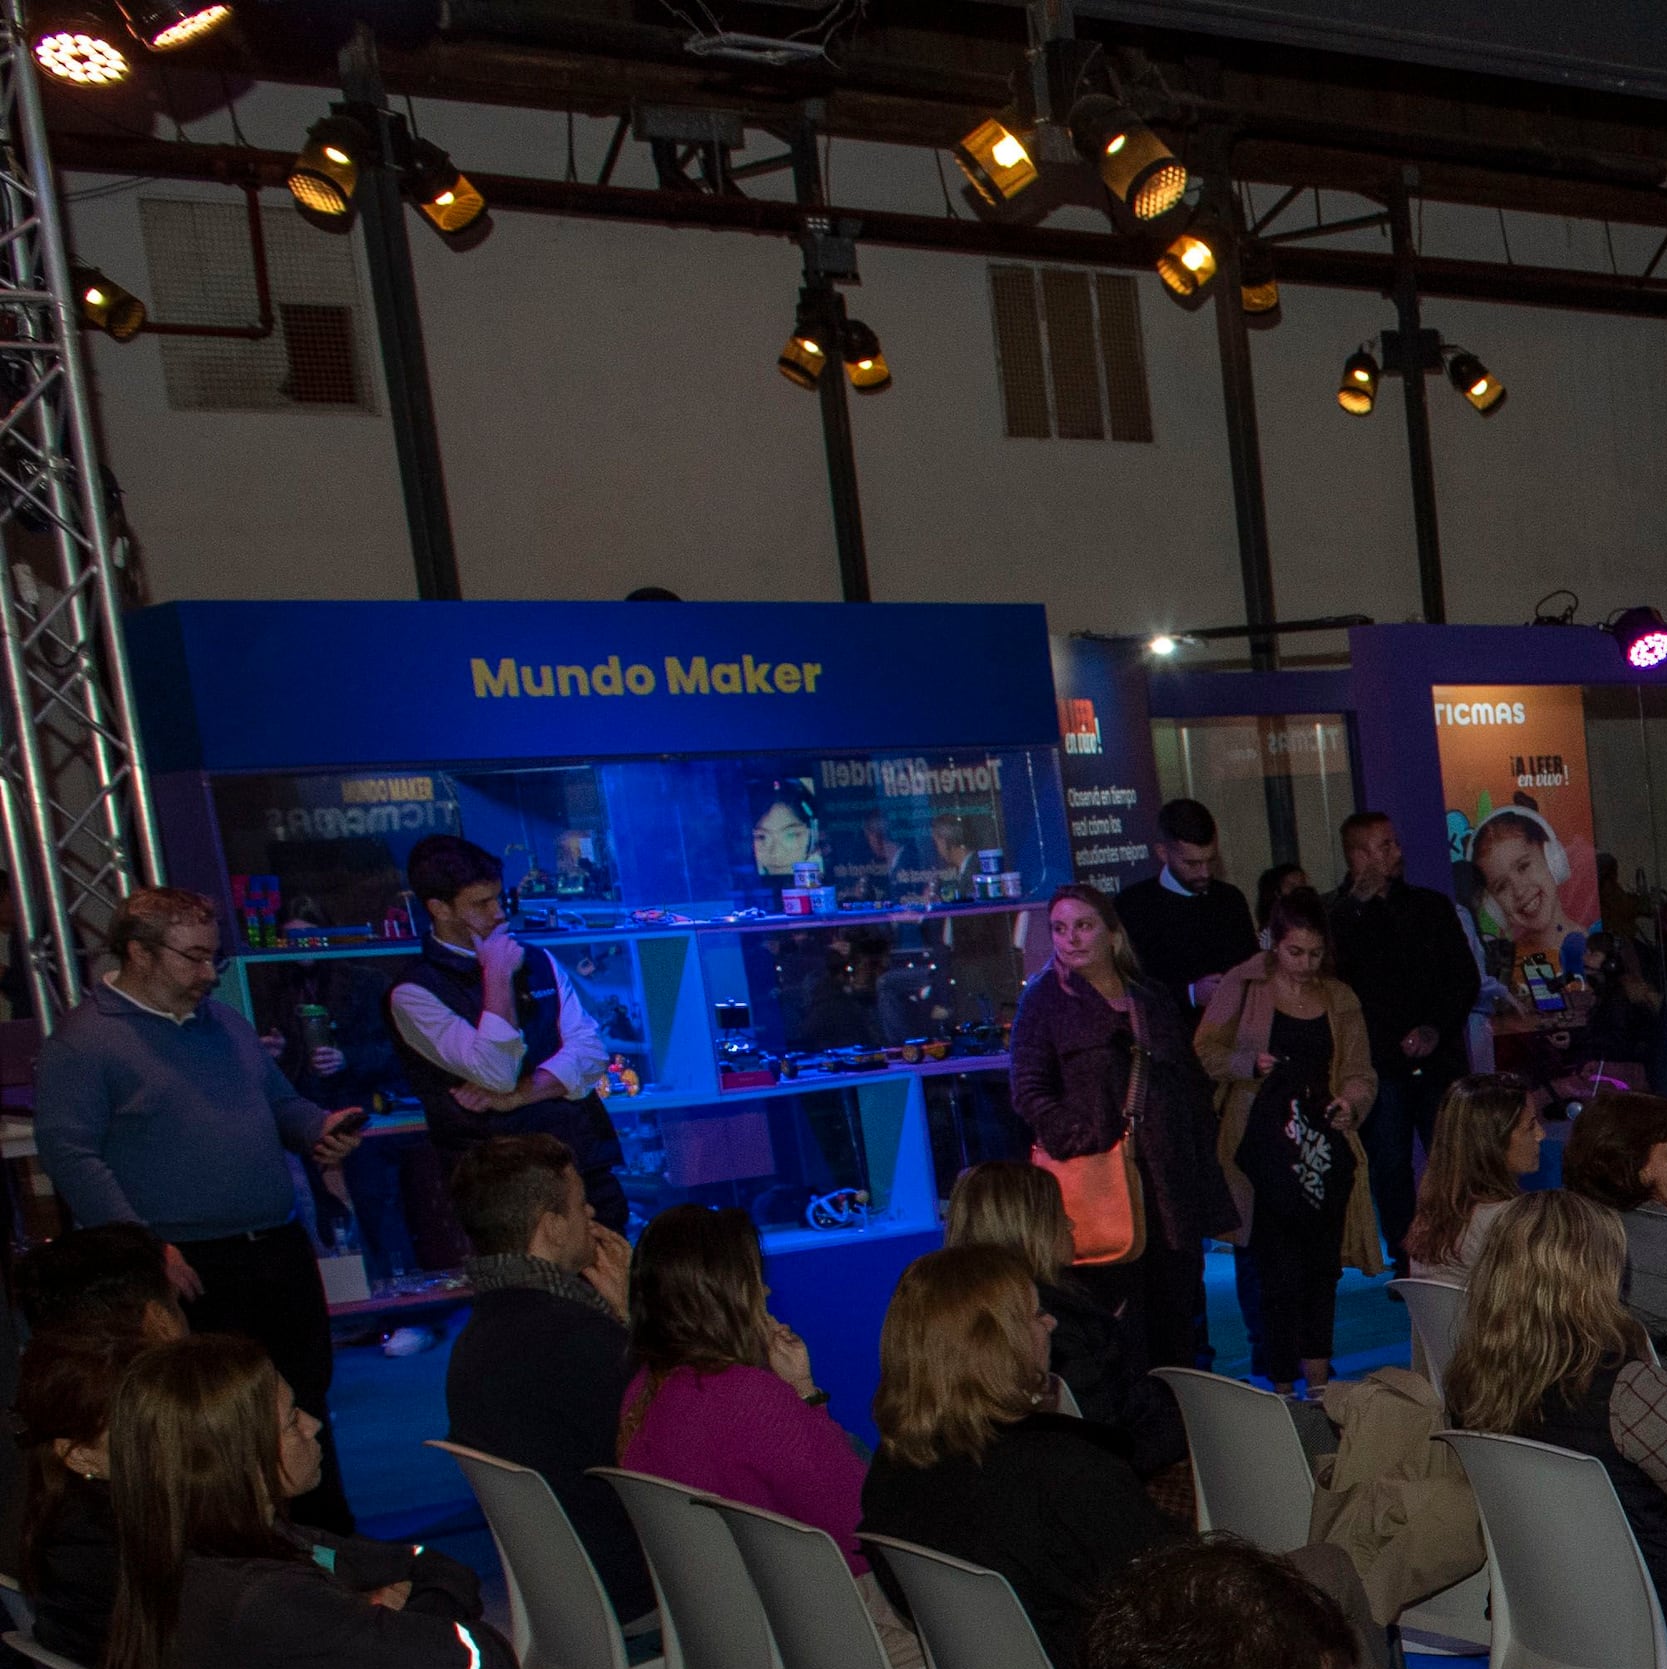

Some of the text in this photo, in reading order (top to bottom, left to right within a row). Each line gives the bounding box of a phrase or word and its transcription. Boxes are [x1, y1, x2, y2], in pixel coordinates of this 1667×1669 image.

[469, 654, 823, 699] Mundo Maker
[1433, 702, 1526, 726] TICMAS
